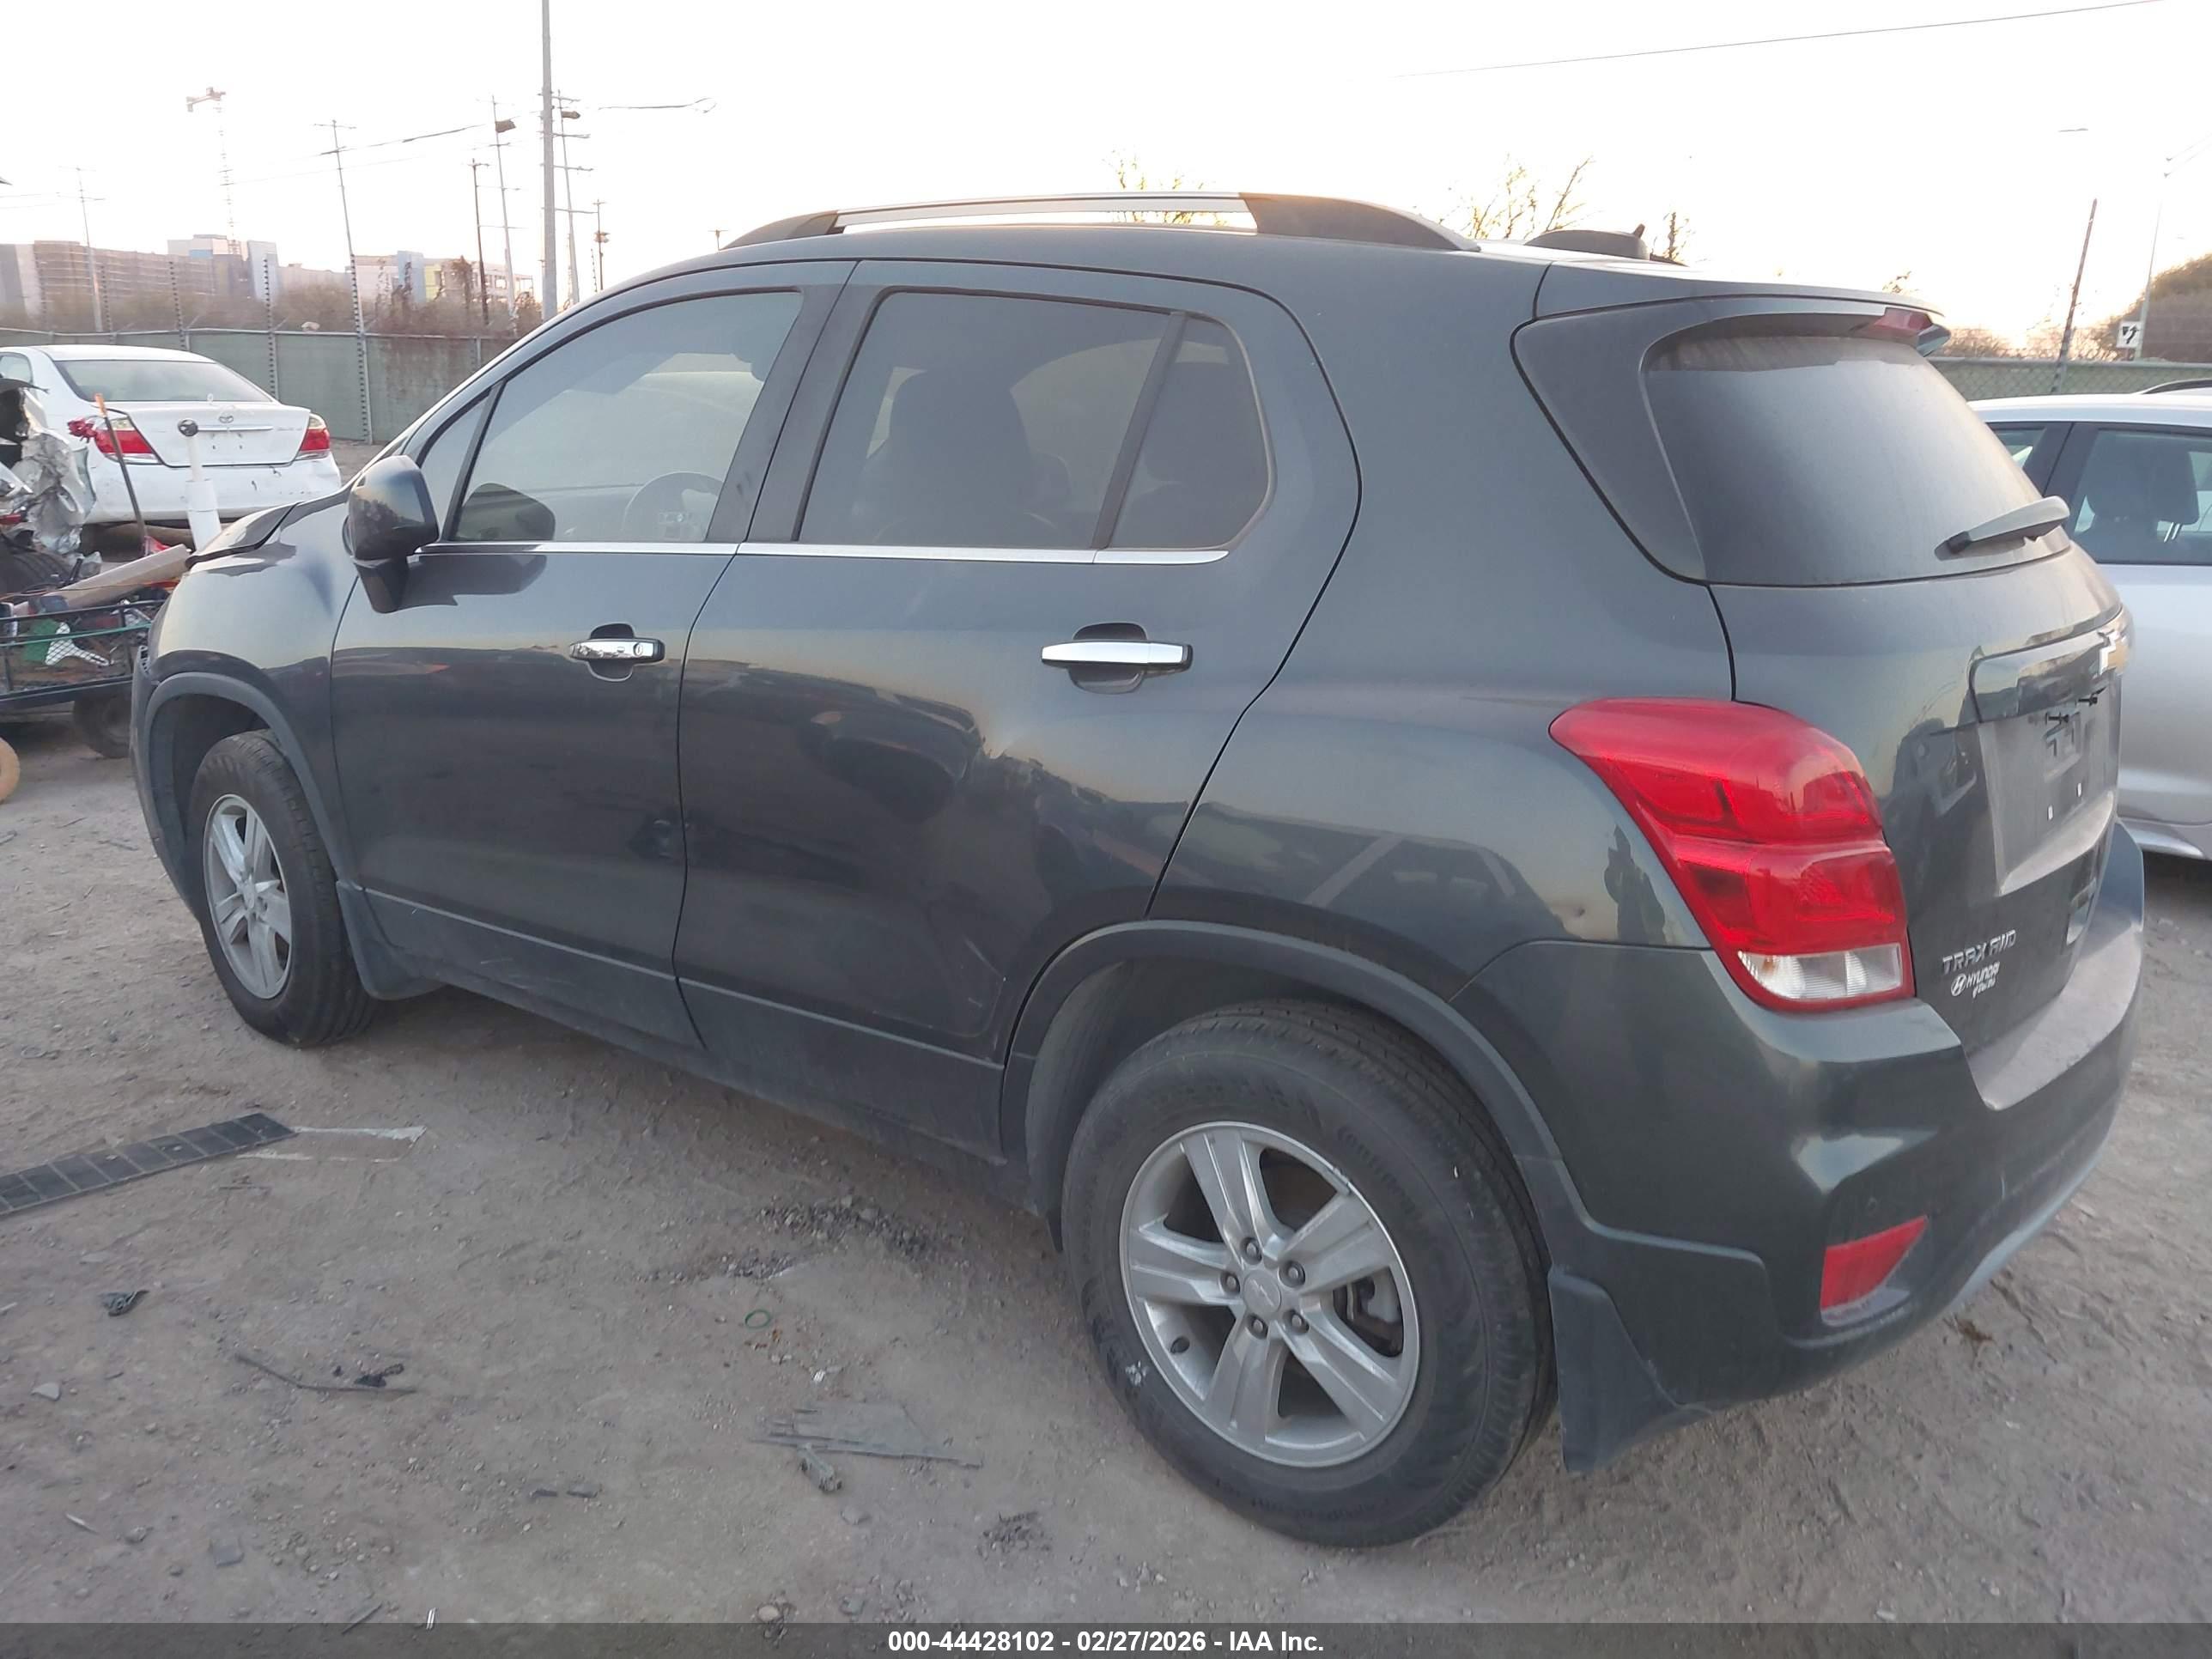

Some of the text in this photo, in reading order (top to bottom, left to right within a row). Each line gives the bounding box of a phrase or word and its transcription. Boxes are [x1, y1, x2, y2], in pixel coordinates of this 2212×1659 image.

[1942, 929, 2017, 975] TRAX AWD
[1966, 961, 2001, 988] HYUNDAI
